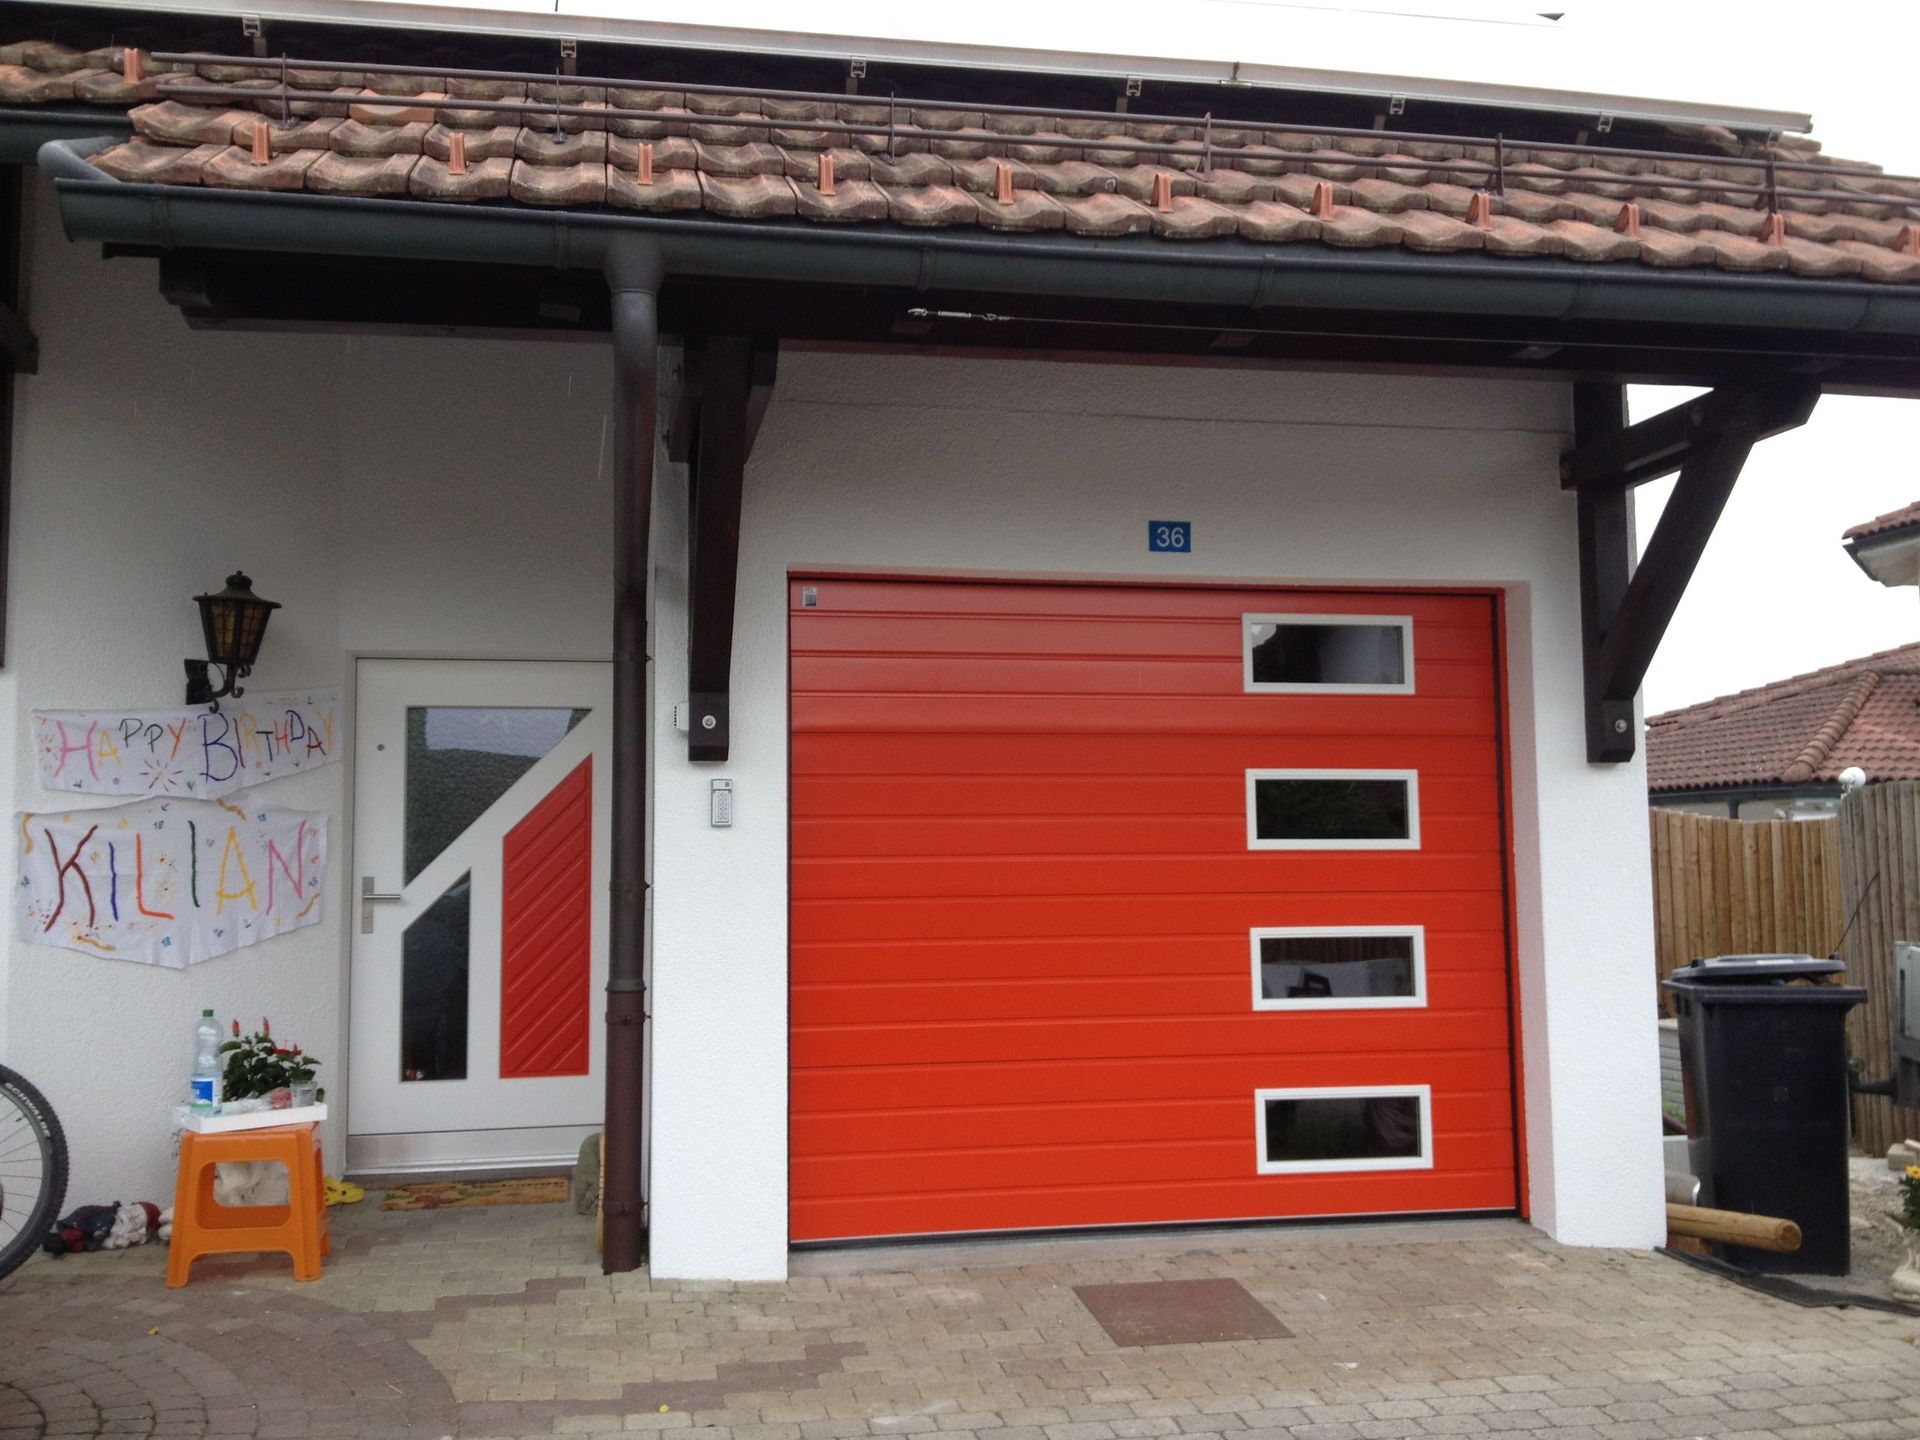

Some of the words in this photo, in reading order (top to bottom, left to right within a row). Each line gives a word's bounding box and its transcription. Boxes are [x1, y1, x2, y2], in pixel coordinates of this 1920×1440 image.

[1156, 526, 1185, 548] 36
[54, 717, 187, 781] HAPPY
[197, 707, 335, 783] BIRTHDAY
[44, 818, 308, 932] KILIAN
